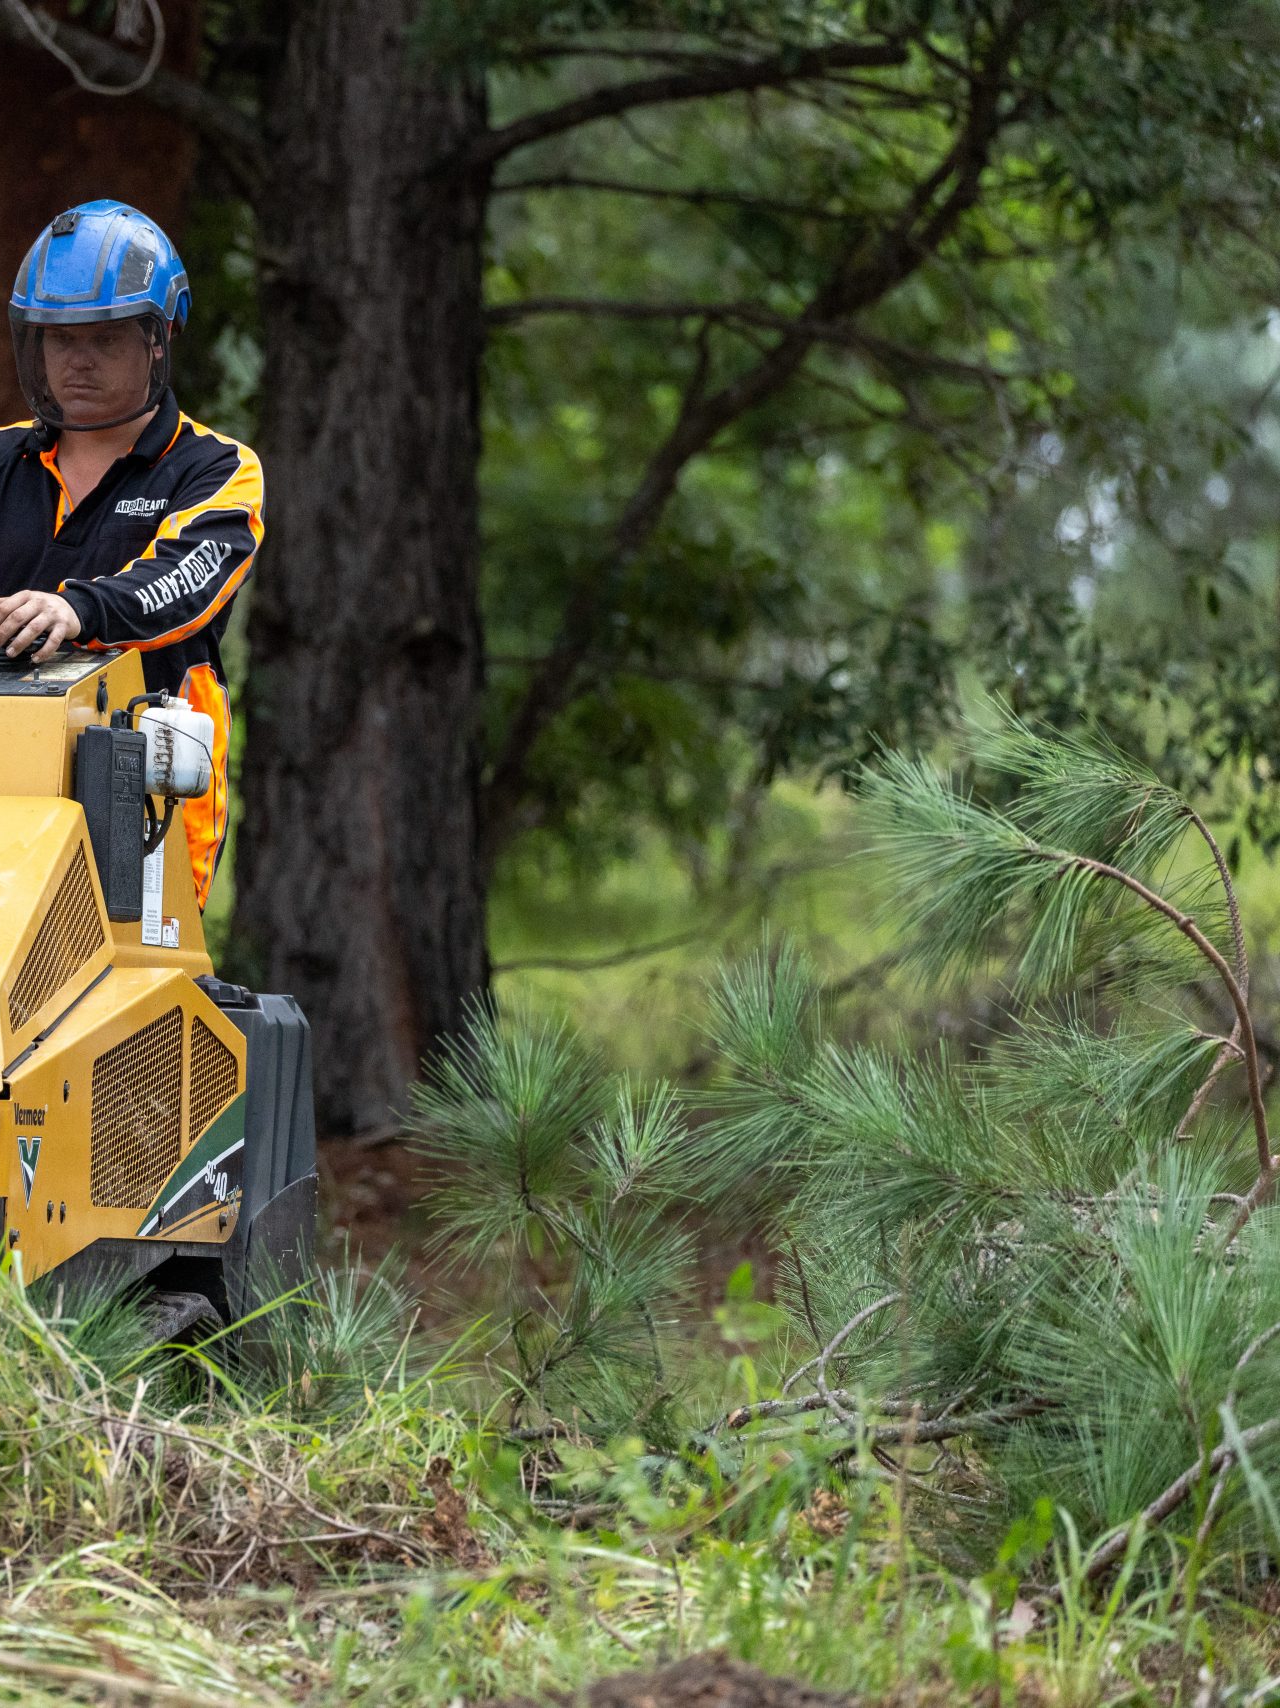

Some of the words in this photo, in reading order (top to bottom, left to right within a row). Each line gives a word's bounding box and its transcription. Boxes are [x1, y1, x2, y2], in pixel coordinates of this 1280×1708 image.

[134, 568, 189, 615] EARTH
[13, 1102, 46, 1126] Vermeer
[213, 1172, 228, 1201] 40
